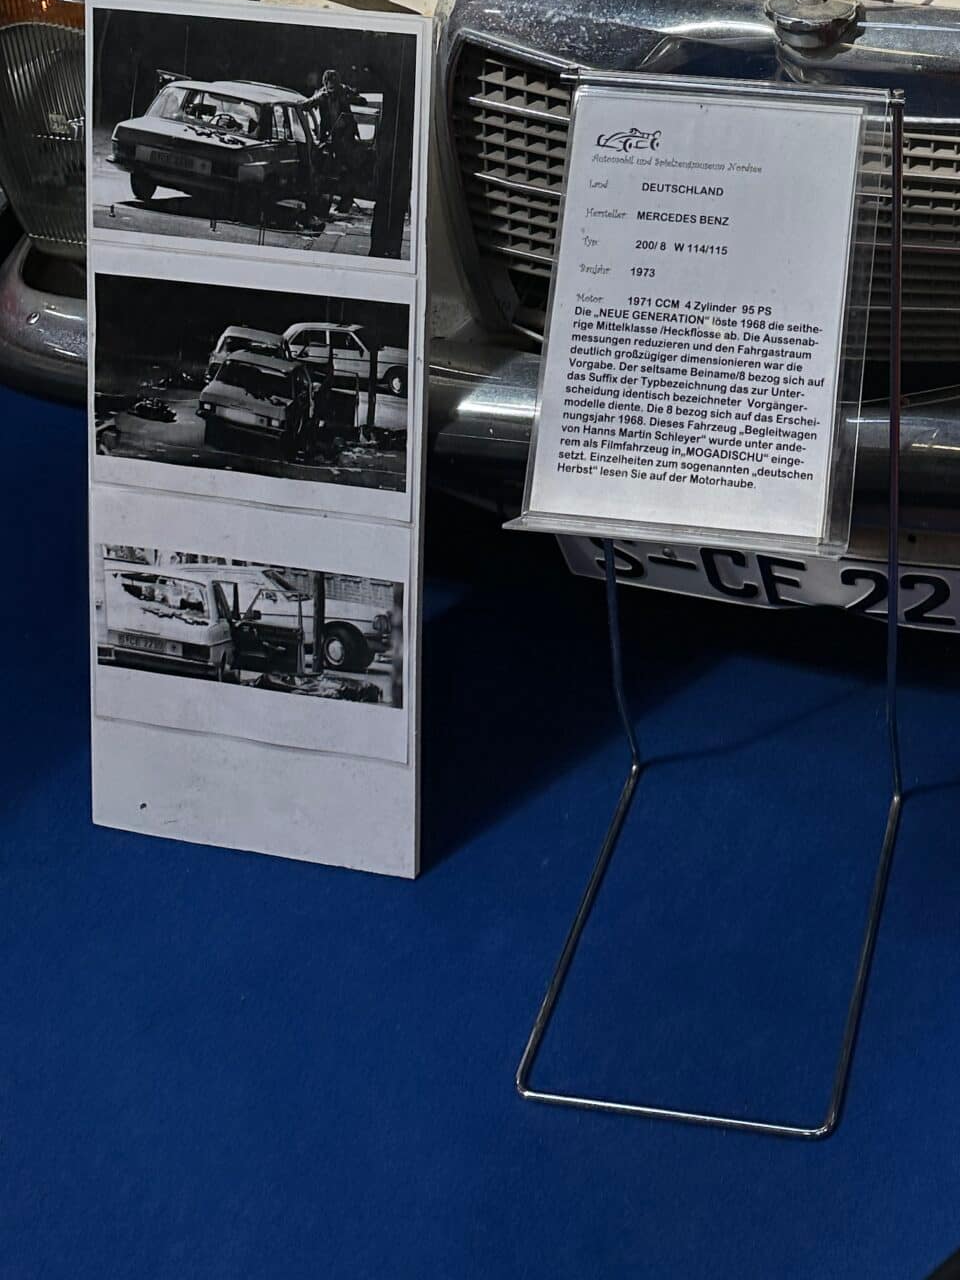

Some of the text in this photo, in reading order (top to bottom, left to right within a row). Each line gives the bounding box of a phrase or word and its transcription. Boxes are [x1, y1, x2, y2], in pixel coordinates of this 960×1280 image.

[641, 182, 725, 197] DEUTSCHLAND
[636, 210, 697, 224] MERCEDES
[699, 214, 730, 227] BENZ
[673, 241, 685, 253] W
[687, 243, 728, 256] 114/115
[630, 266, 656, 278] 1973
[574, 305, 593, 317] Die
[711, 316, 738, 328] löste
[740, 318, 767, 330] 1968
[767, 320, 785, 332] die
[786, 323, 824, 335] seithe-
[627, 296, 652, 308] 1971
[654, 297, 681, 310] CCM
[684, 300, 692, 310] 4
[693, 300, 738, 314] Zylinder
[741, 304, 756, 315] 95
[756, 305, 773, 317] PS
[571, 333, 812, 361] messungen reduzieren und den Fahrgastraum
[572, 319, 594, 331] rige
[595, 320, 658, 335] Mittelklasse
[723, 330, 740, 341] ab.
[742, 331, 761, 343] Die
[762, 333, 820, 348] Aussenab-
[568, 357, 825, 388] Vorgabe. Der seltsame Beiname/8 bezog sich auf
[569, 344, 804, 373] deutlich großzügiger dimensionieren war die
[566, 369, 805, 399] das Suffix der Typbezeichnung das zur Unter-
[563, 397, 606, 409] modelle
[607, 400, 644, 413] diente.
[646, 403, 665, 414] Die
[675, 405, 708, 420] bezog
[709, 408, 733, 420] sich
[734, 411, 753, 422] auf
[753, 411, 774, 424] das
[775, 413, 821, 427] Erschei-
[565, 384, 808, 414] scheidung identisch bezeichneter Vorgänger-
[562, 411, 617, 424] nungsjahr
[618, 414, 647, 426] 1968.
[648, 416, 685, 430] Dieses
[687, 419, 737, 436] Fahrzeug
[559, 437, 581, 448] rem
[582, 438, 599, 449] als
[600, 439, 670, 457] Filmfahrzeug
[770, 455, 805, 468] einge-
[561, 424, 581, 434] von
[582, 424, 617, 437] Hanns
[618, 427, 652, 440] Martin
[708, 436, 743, 448] wurde
[744, 439, 774, 450] unter
[775, 441, 807, 453] ande-
[558, 450, 587, 461] setzt.
[589, 451, 654, 467] Einzelheiten
[655, 459, 679, 470] zum
[680, 461, 750, 476] sogenannten
[599, 465, 629, 479] lesen
[630, 468, 648, 480] Sie
[649, 471, 668, 482] auf
[668, 471, 688, 484] der
[689, 473, 757, 489] Motorhaube.
